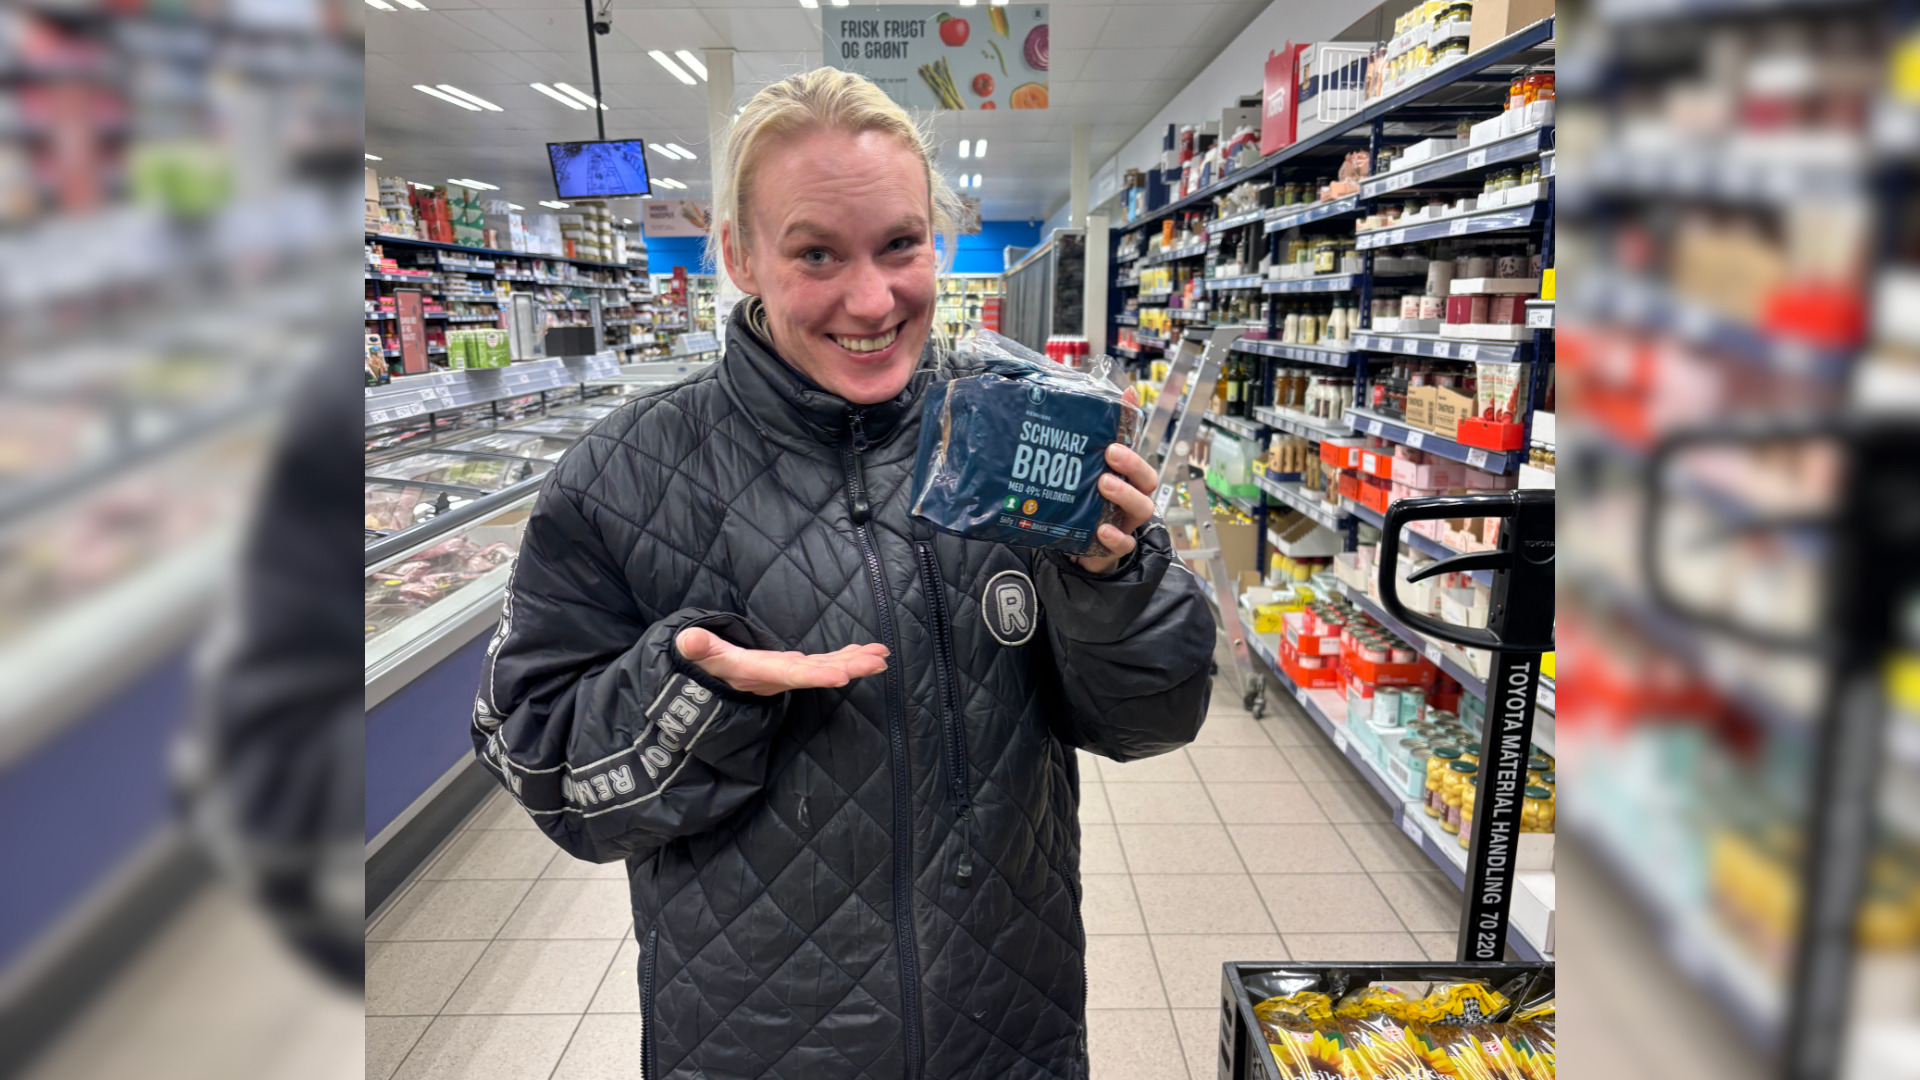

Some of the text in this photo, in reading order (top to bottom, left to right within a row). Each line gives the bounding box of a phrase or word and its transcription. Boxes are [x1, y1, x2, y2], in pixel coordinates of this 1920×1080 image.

[841, 20, 926, 38] FRISK FRUGT
[841, 41, 909, 59] OG GRØNT
[1020, 421, 1089, 455] SCHWARZ
[1011, 444, 1083, 491] BRØD
[1008, 481, 1077, 504] MED 49% FULDKORN
[996, 583, 1029, 635] R
[1476, 662, 1530, 958] TOYOTA MATERIAL HANDLING 70 220
